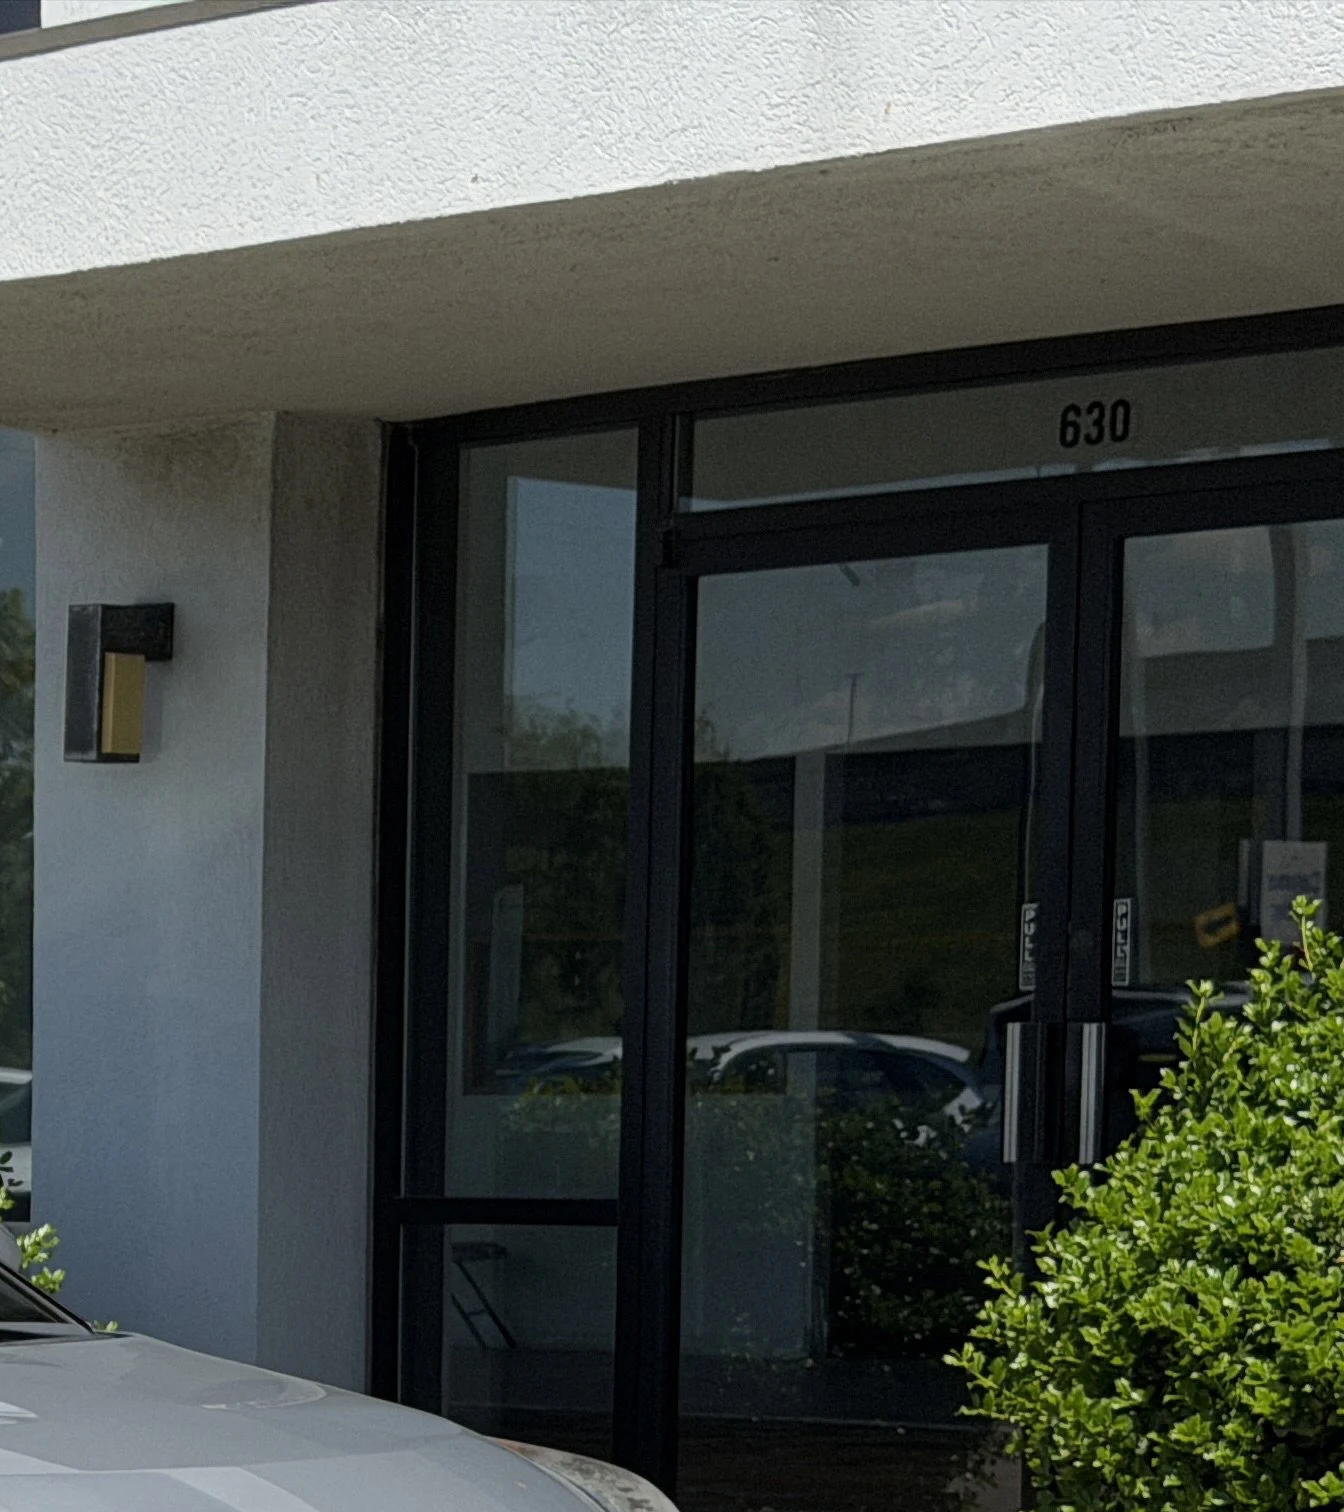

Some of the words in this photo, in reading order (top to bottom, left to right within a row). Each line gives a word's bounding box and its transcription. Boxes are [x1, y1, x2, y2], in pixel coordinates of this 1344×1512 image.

[1059, 399, 1131, 448] 630
[1024, 909, 1036, 962] PULL
[1116, 903, 1127, 957] PULL
